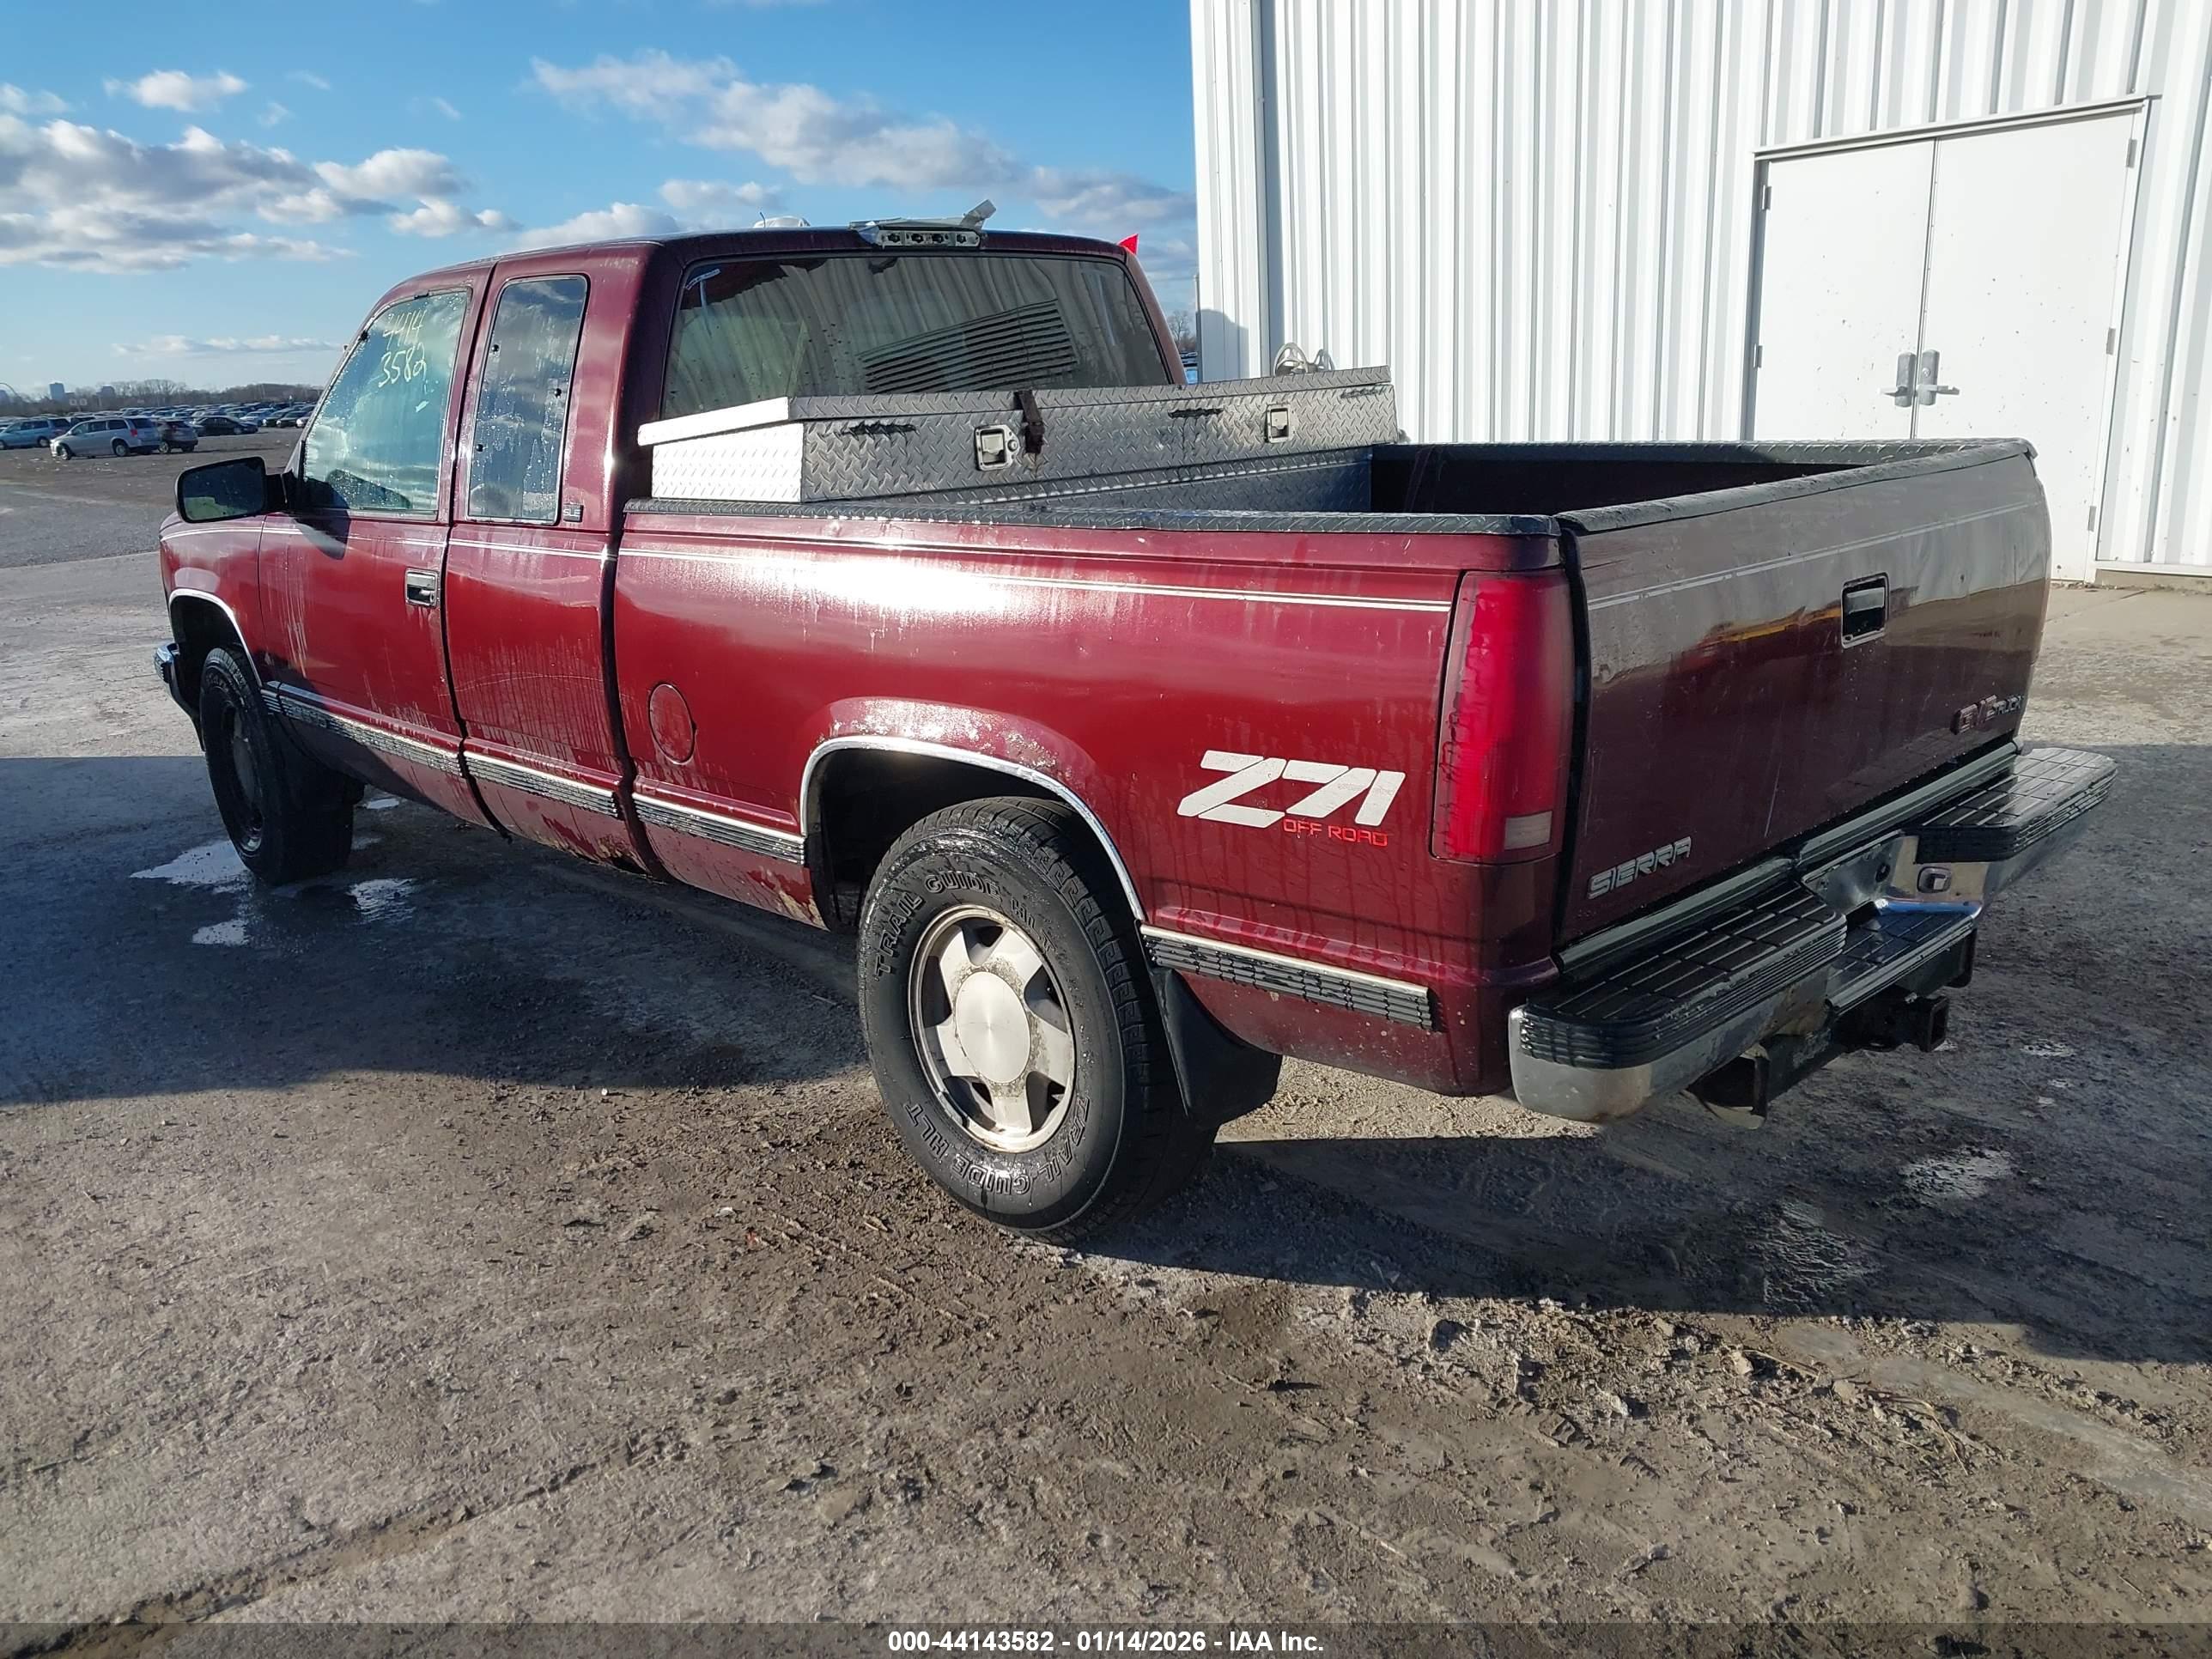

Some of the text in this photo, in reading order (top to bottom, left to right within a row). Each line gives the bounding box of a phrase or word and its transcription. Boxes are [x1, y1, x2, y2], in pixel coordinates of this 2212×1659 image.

[378, 342, 428, 388] 3582
[562, 507, 581, 517] SLE
[1177, 750, 1406, 829] Z71
[1282, 818, 1389, 848] OFF ROAD
[1588, 836, 1692, 900] SIERRA
[874, 892, 925, 975] TRAIL
[924, 870, 1003, 902] GUIDE
[902, 1096, 1091, 1195] TRAIL GUIDE HLT
